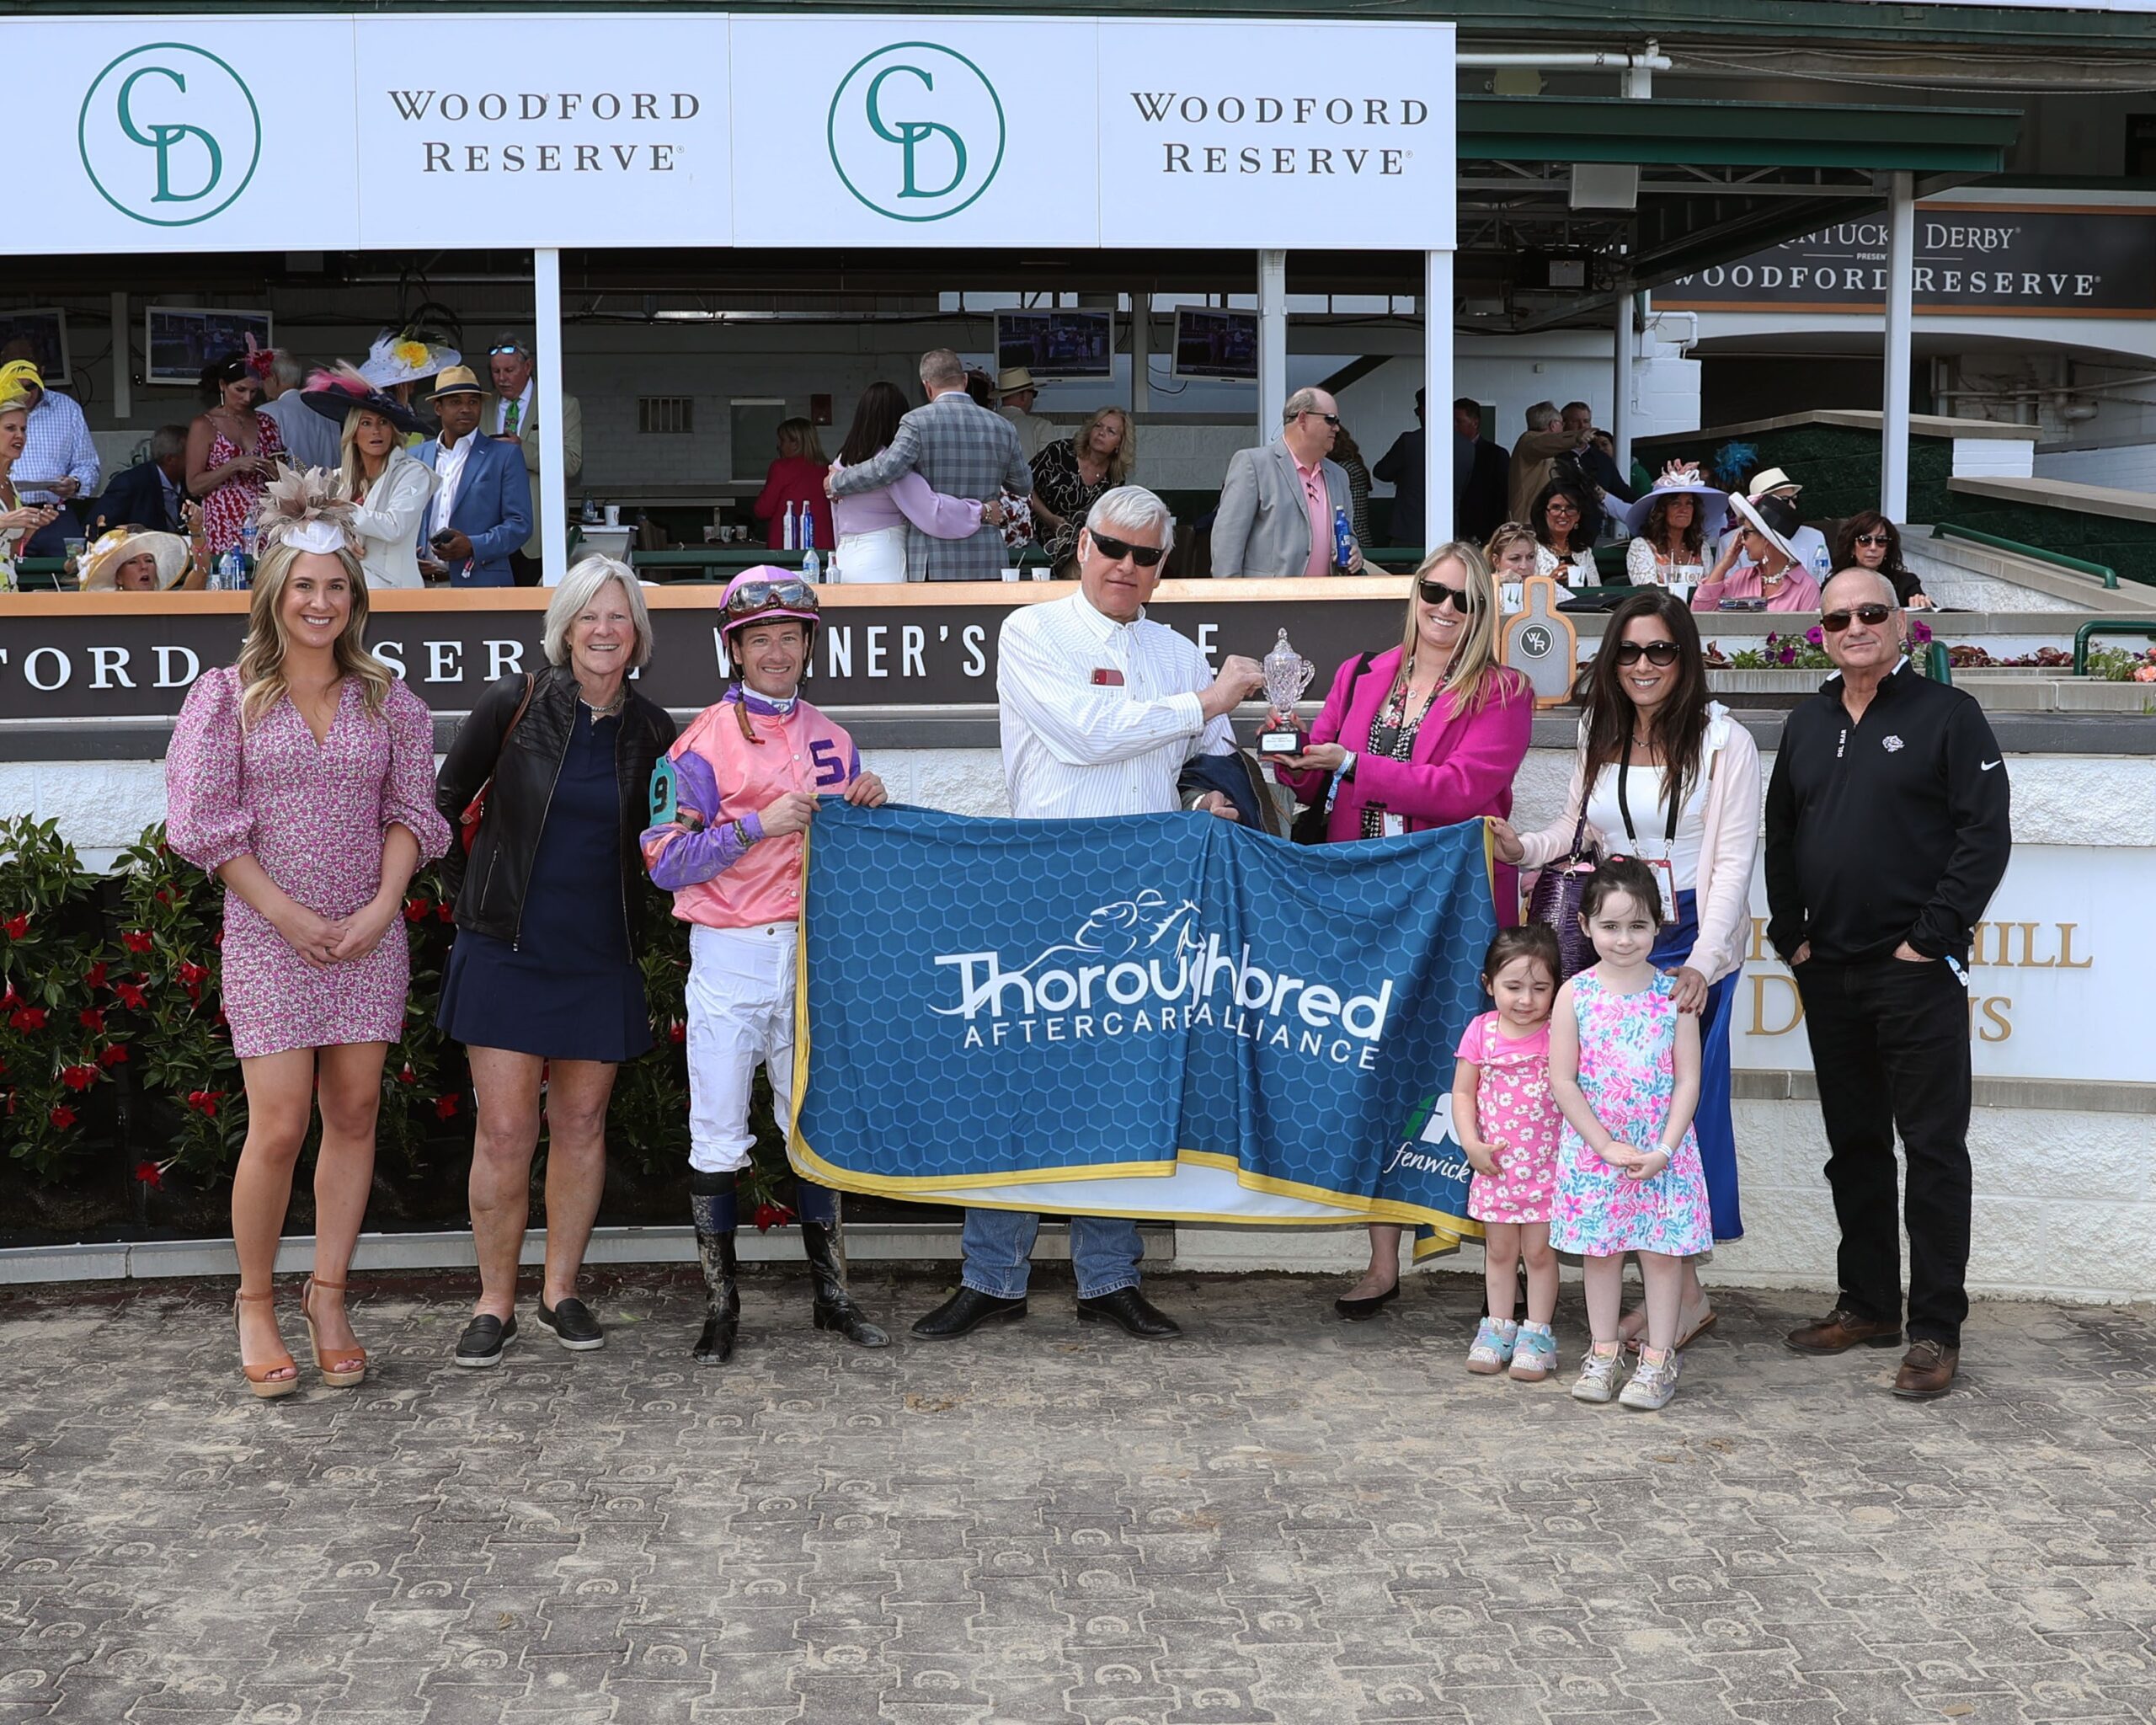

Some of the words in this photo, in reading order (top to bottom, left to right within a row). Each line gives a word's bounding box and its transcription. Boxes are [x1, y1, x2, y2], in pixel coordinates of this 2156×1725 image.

[387, 90, 700, 121] WOODFORD
[1131, 93, 1428, 126] WOODFORD
[1856, 252, 1887, 261] PRESEN
[808, 739, 846, 787] 5
[653, 775, 669, 814] 9
[1193, 1002, 1380, 1071] ALLIANCE
[1383, 1141, 1470, 1183] fenwick
